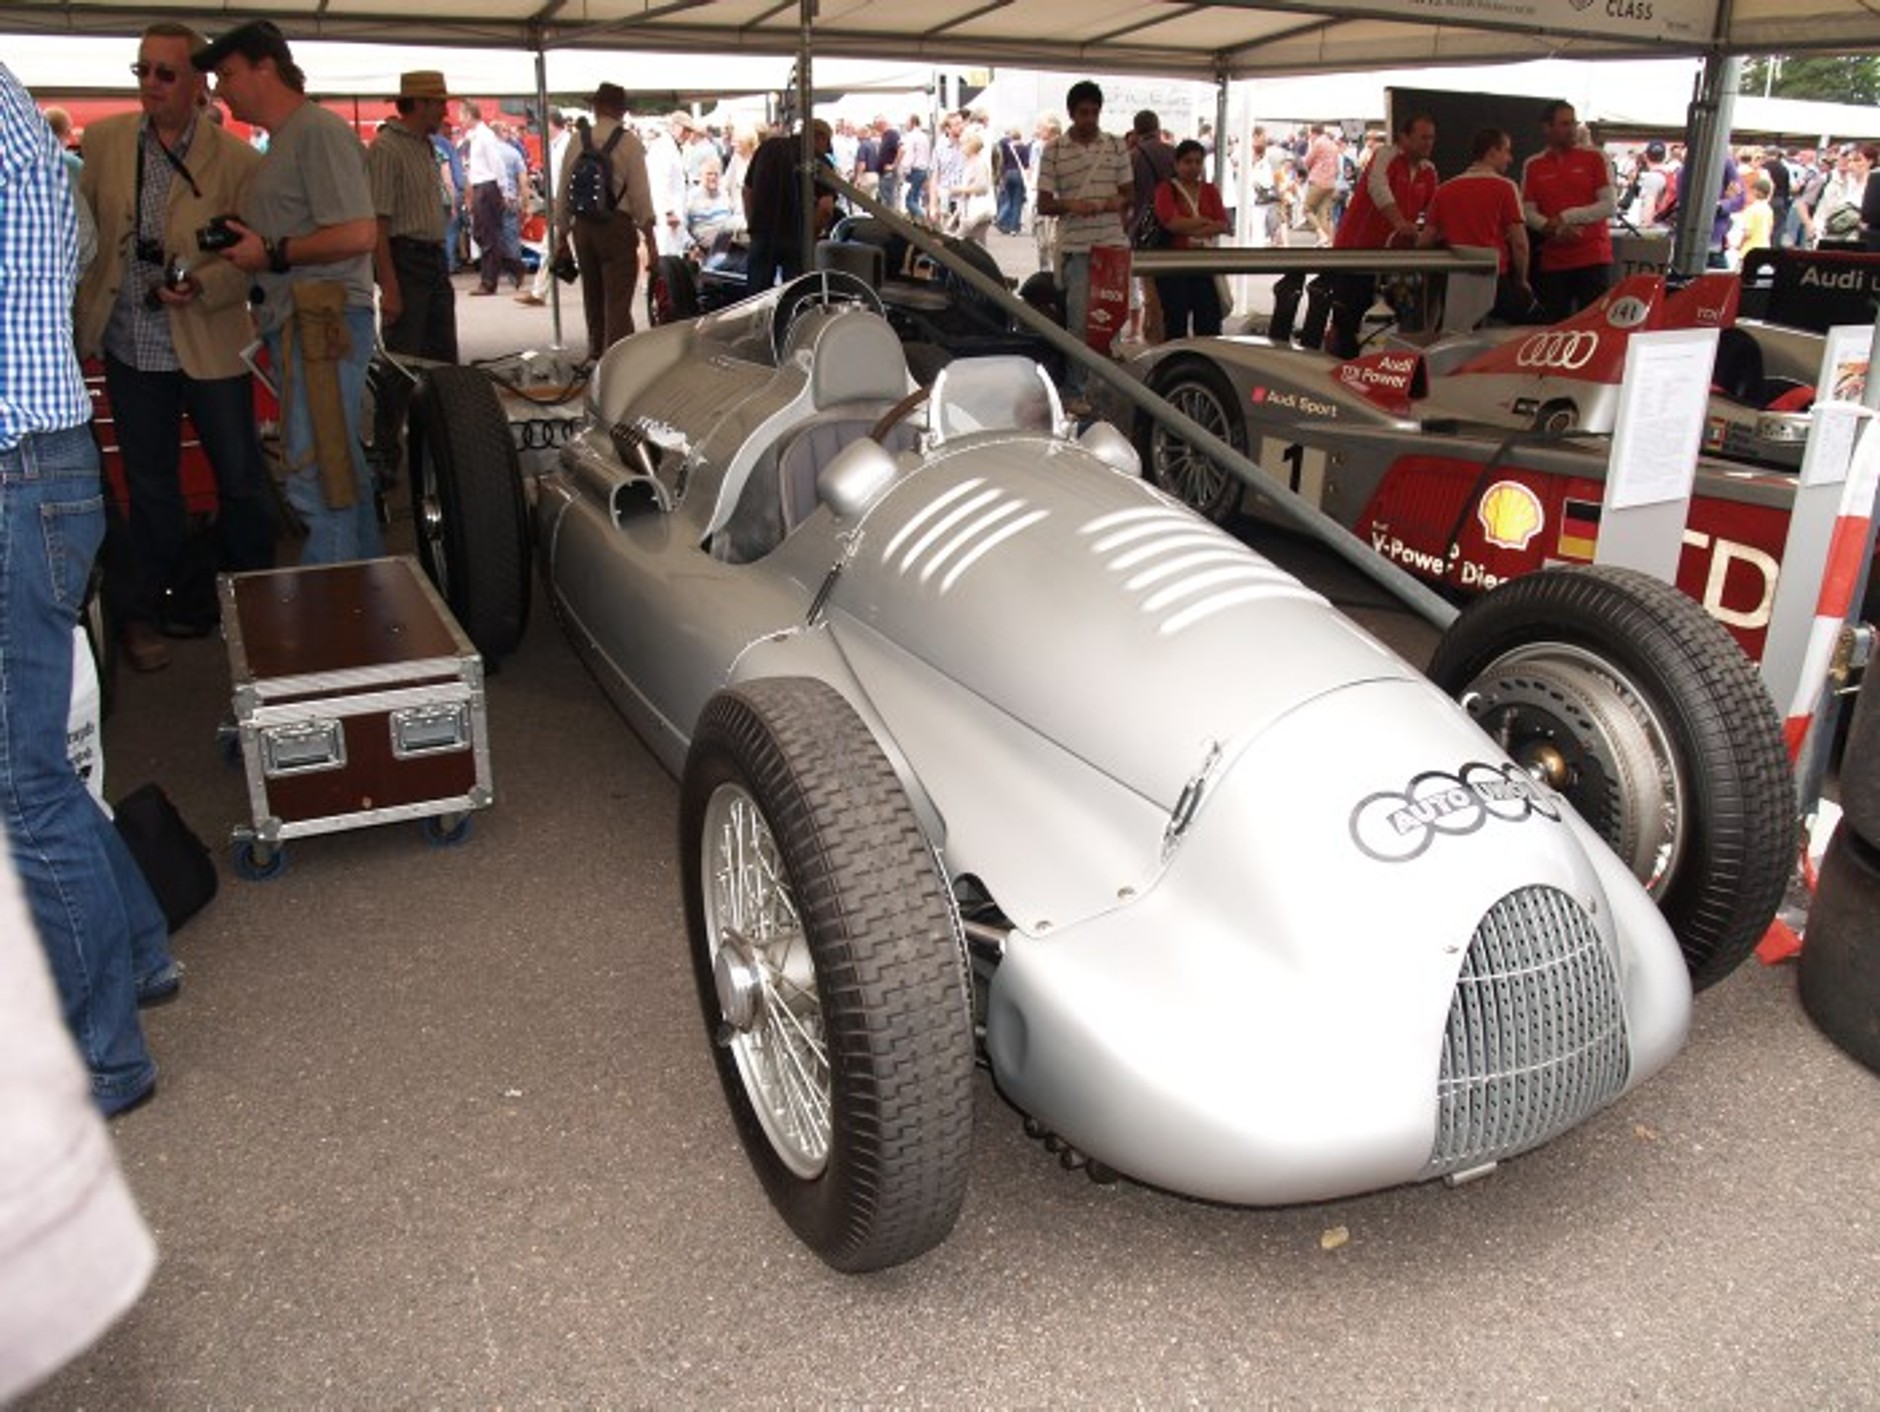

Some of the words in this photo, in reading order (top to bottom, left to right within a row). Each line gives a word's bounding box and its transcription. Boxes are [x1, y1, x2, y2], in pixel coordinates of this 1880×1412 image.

[1606, 0, 1653, 20] CLASS
[1800, 266, 1864, 291] Audi
[1378, 355, 1414, 373] Audi
[1361, 369, 1407, 388] Power
[1267, 390, 1297, 407] Audi
[1299, 396, 1337, 418] Sport
[1281, 442, 1304, 494] 1
[1386, 786, 1472, 836] AUTO
